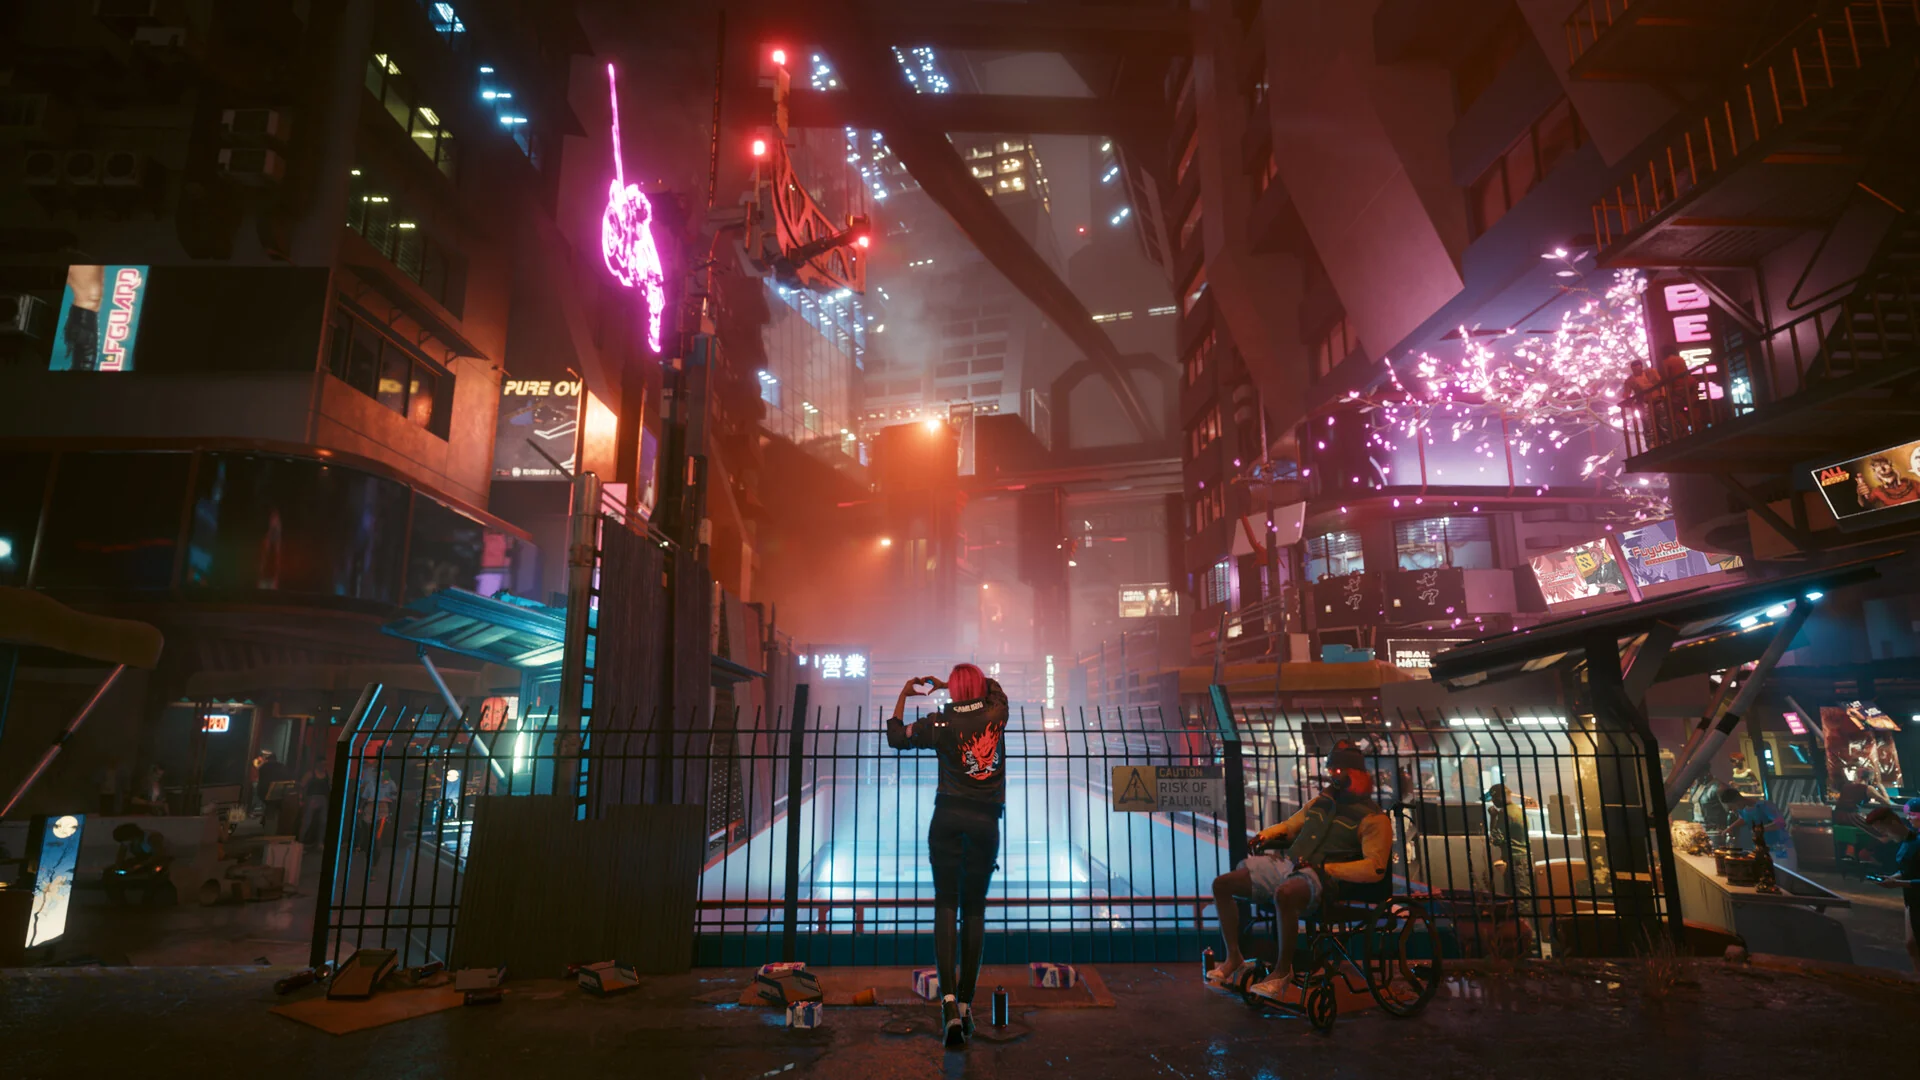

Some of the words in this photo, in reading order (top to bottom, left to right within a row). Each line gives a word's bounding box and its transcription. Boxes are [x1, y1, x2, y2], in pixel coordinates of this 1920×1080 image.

[503, 381, 551, 396] PURE
[1821, 466, 1847, 480] ALL
[1631, 540, 1682, 559] Fuyutsu
[1396, 650, 1430, 658] REAL
[1159, 767, 1204, 778] CAUTION
[1160, 782, 1188, 793] RISK
[1192, 782, 1208, 793] OF
[1161, 796, 1212, 807] FALLING
